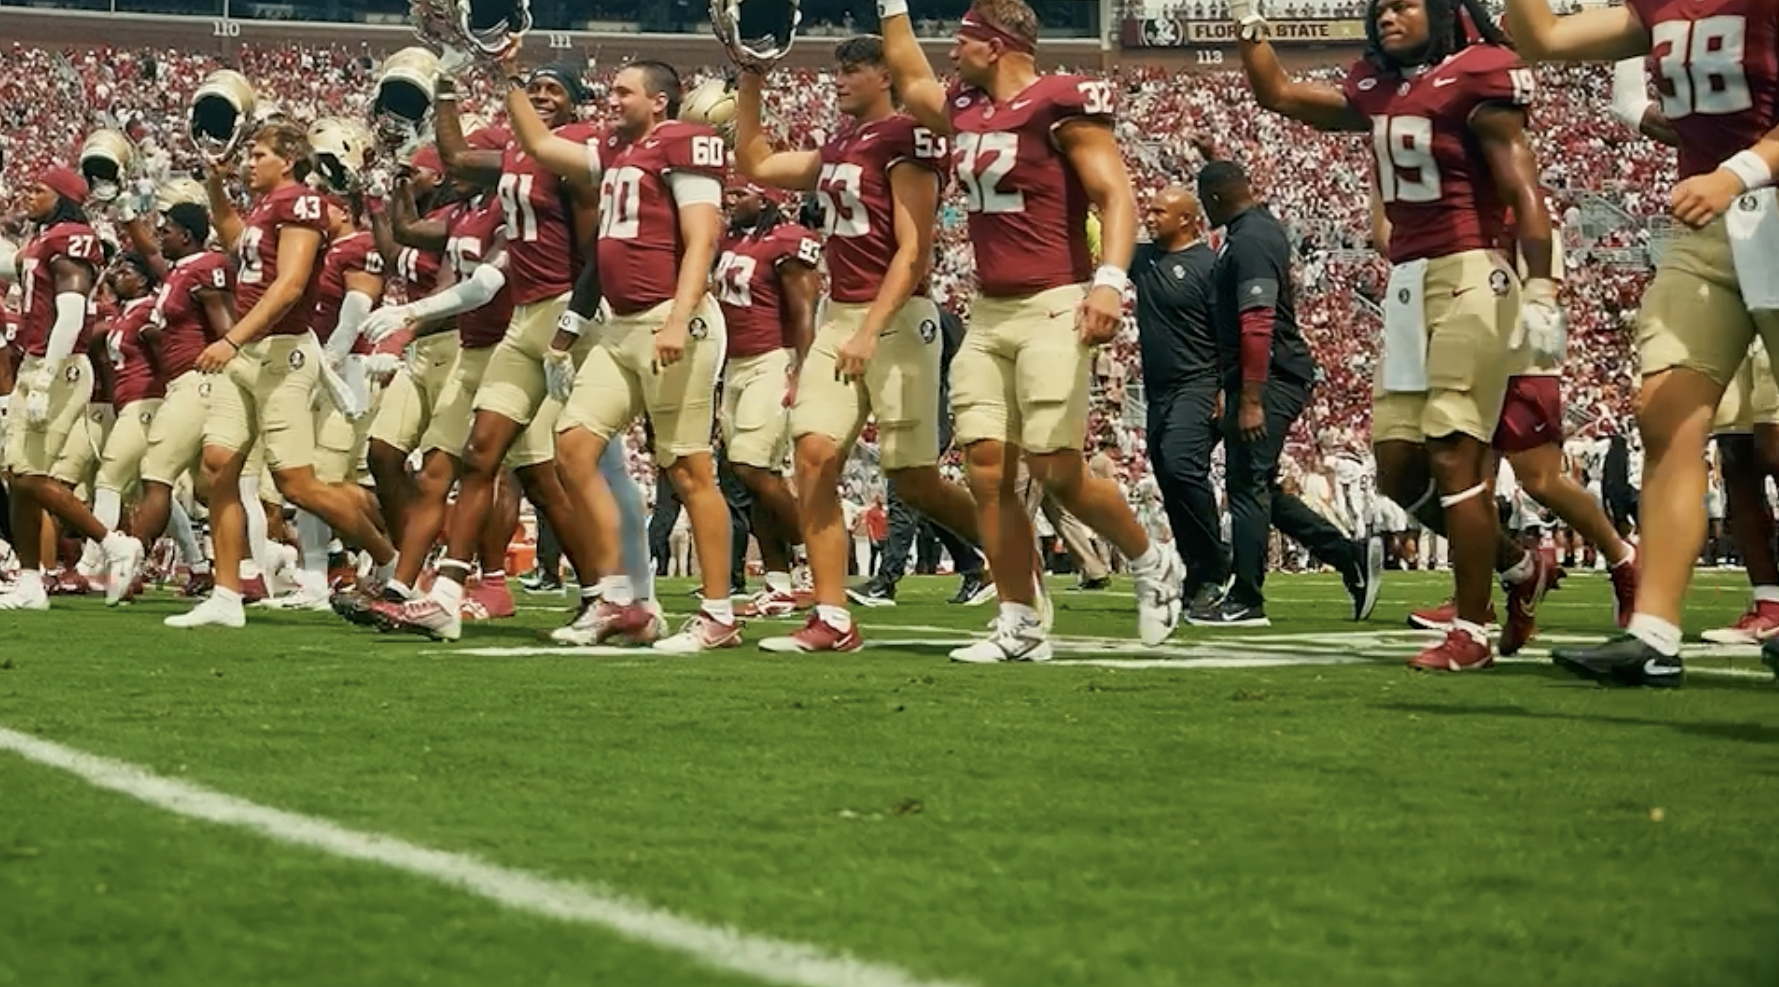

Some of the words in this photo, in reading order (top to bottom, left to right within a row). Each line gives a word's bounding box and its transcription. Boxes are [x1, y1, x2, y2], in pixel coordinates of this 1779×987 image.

[213, 21, 241, 37] 110
[1275, 24, 1330, 38] STATE
[1652, 16, 1753, 120] 38
[1077, 81, 1115, 114] 32
[692, 136, 724, 166] 60
[1371, 115, 1443, 203] 19
[293, 195, 321, 220] 43
[68, 234, 95, 257] 27
[212, 267, 226, 288] 8
[5, 322, 19, 341] 8
